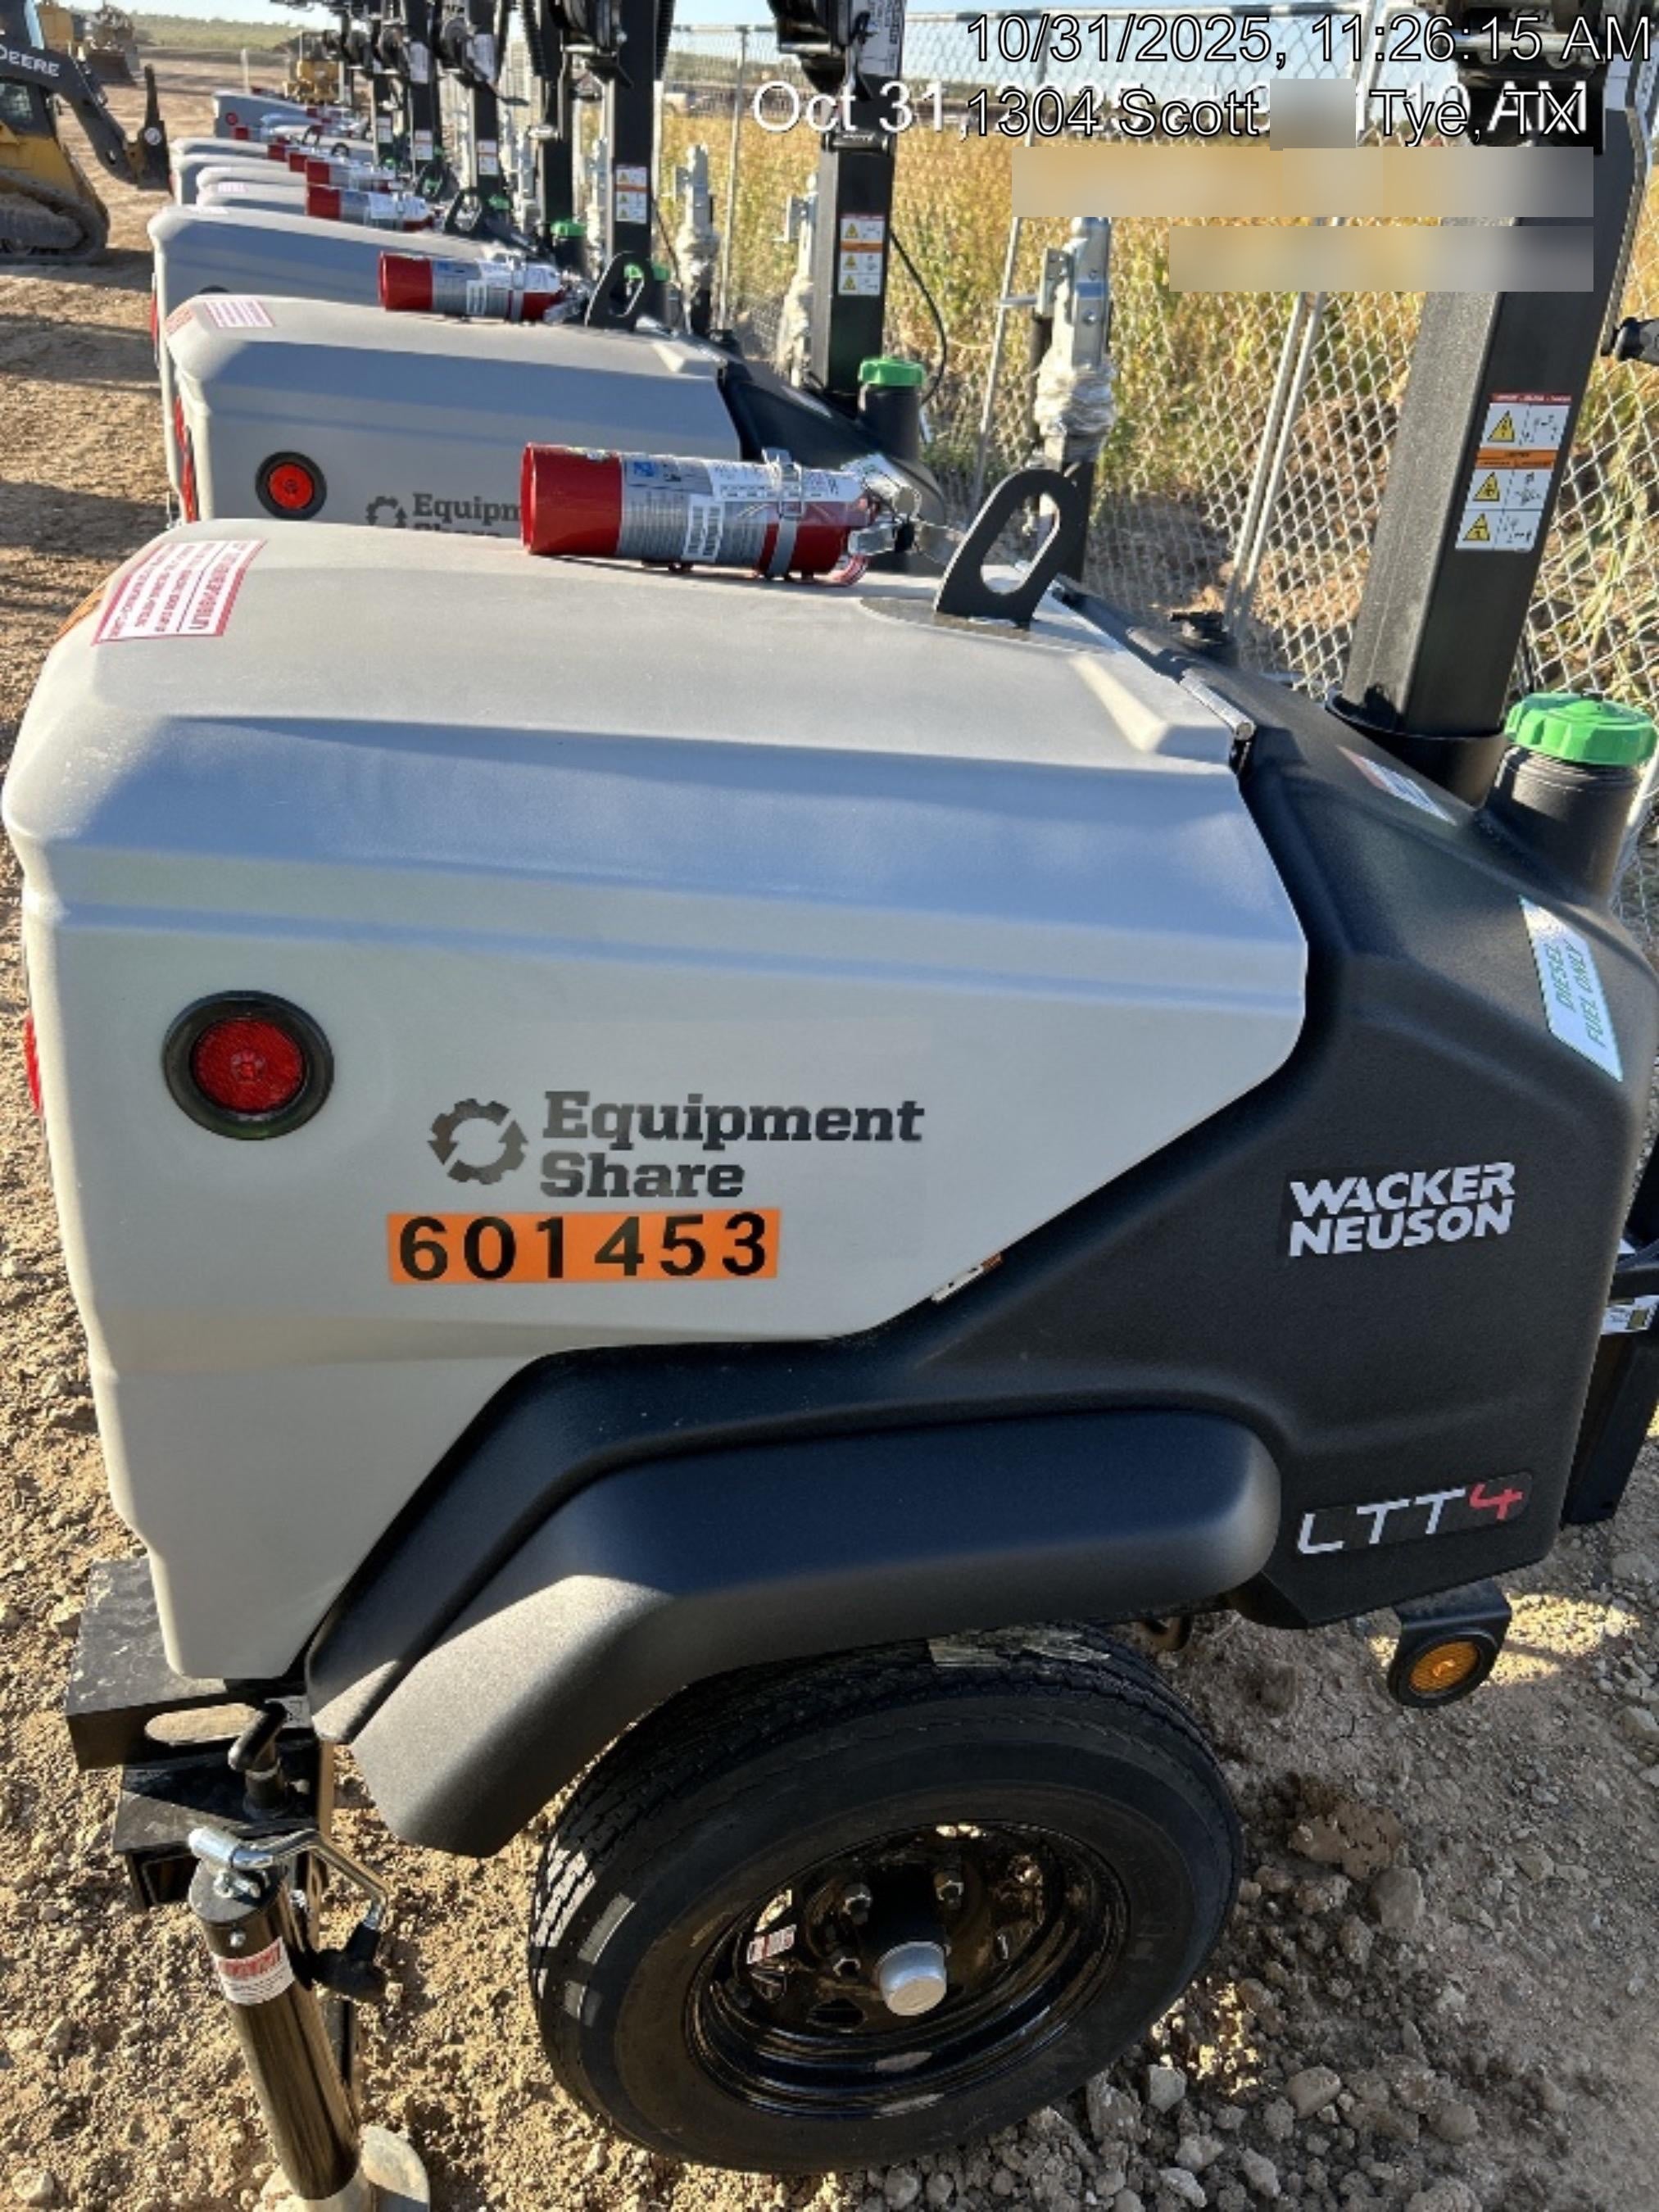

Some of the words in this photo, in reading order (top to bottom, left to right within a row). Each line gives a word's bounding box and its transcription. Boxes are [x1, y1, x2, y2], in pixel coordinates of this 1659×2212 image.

[412, 492, 521, 526] Equipm
[542, 1090, 926, 1151] Equipment
[540, 1151, 746, 1199] Share
[1290, 1161, 1517, 1217] WACKER
[398, 1211, 768, 1281] 601453
[1289, 1198, 1515, 1258] NEUSON
